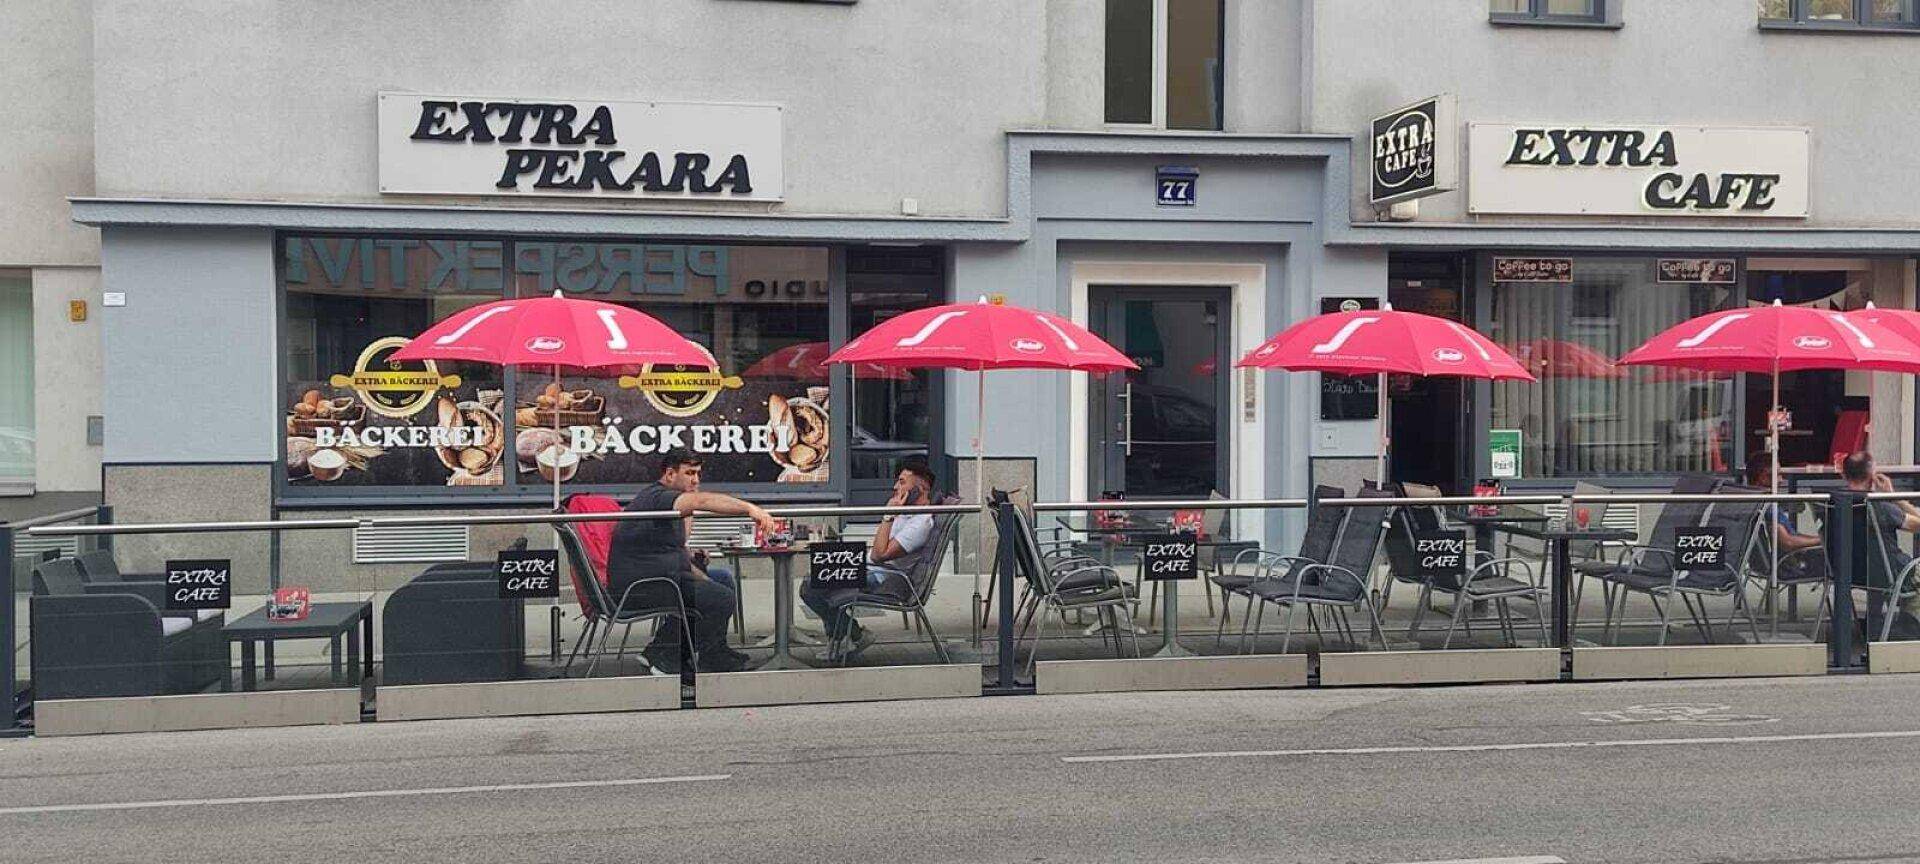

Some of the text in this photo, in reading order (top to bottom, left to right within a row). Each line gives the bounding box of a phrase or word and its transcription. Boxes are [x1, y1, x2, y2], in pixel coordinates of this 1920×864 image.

[410, 100, 617, 145] EXTRA
[1376, 120, 1433, 158] EXTRA
[1505, 129, 1679, 167] EXTRA
[1384, 149, 1417, 173] CAFE
[496, 149, 753, 193] PEKARA
[1163, 181, 1189, 199] 77
[1644, 172, 1781, 210] CAFE
[1540, 260, 1553, 271] to
[1555, 262, 1569, 274] go
[355, 377, 387, 386] EXTRA
[641, 378, 672, 387] EXTRA
[315, 419, 486, 448] BÄCKEREI
[569, 416, 792, 453] BÄCKEREI
[1146, 542, 1195, 557] EXTRA
[1417, 538, 1464, 553] EXTRA
[1678, 535, 1723, 550] EXTRA
[813, 550, 864, 566] EXTRA
[1422, 555, 1459, 569] CAFE
[1682, 551, 1718, 565] CAFE
[501, 558, 555, 575] EXTRA
[1152, 559, 1190, 573] CAFE
[168, 568, 228, 585] EXTRA
[817, 567, 858, 582] CAFE
[507, 576, 550, 590] CAFE
[174, 587, 221, 602] CAFE
